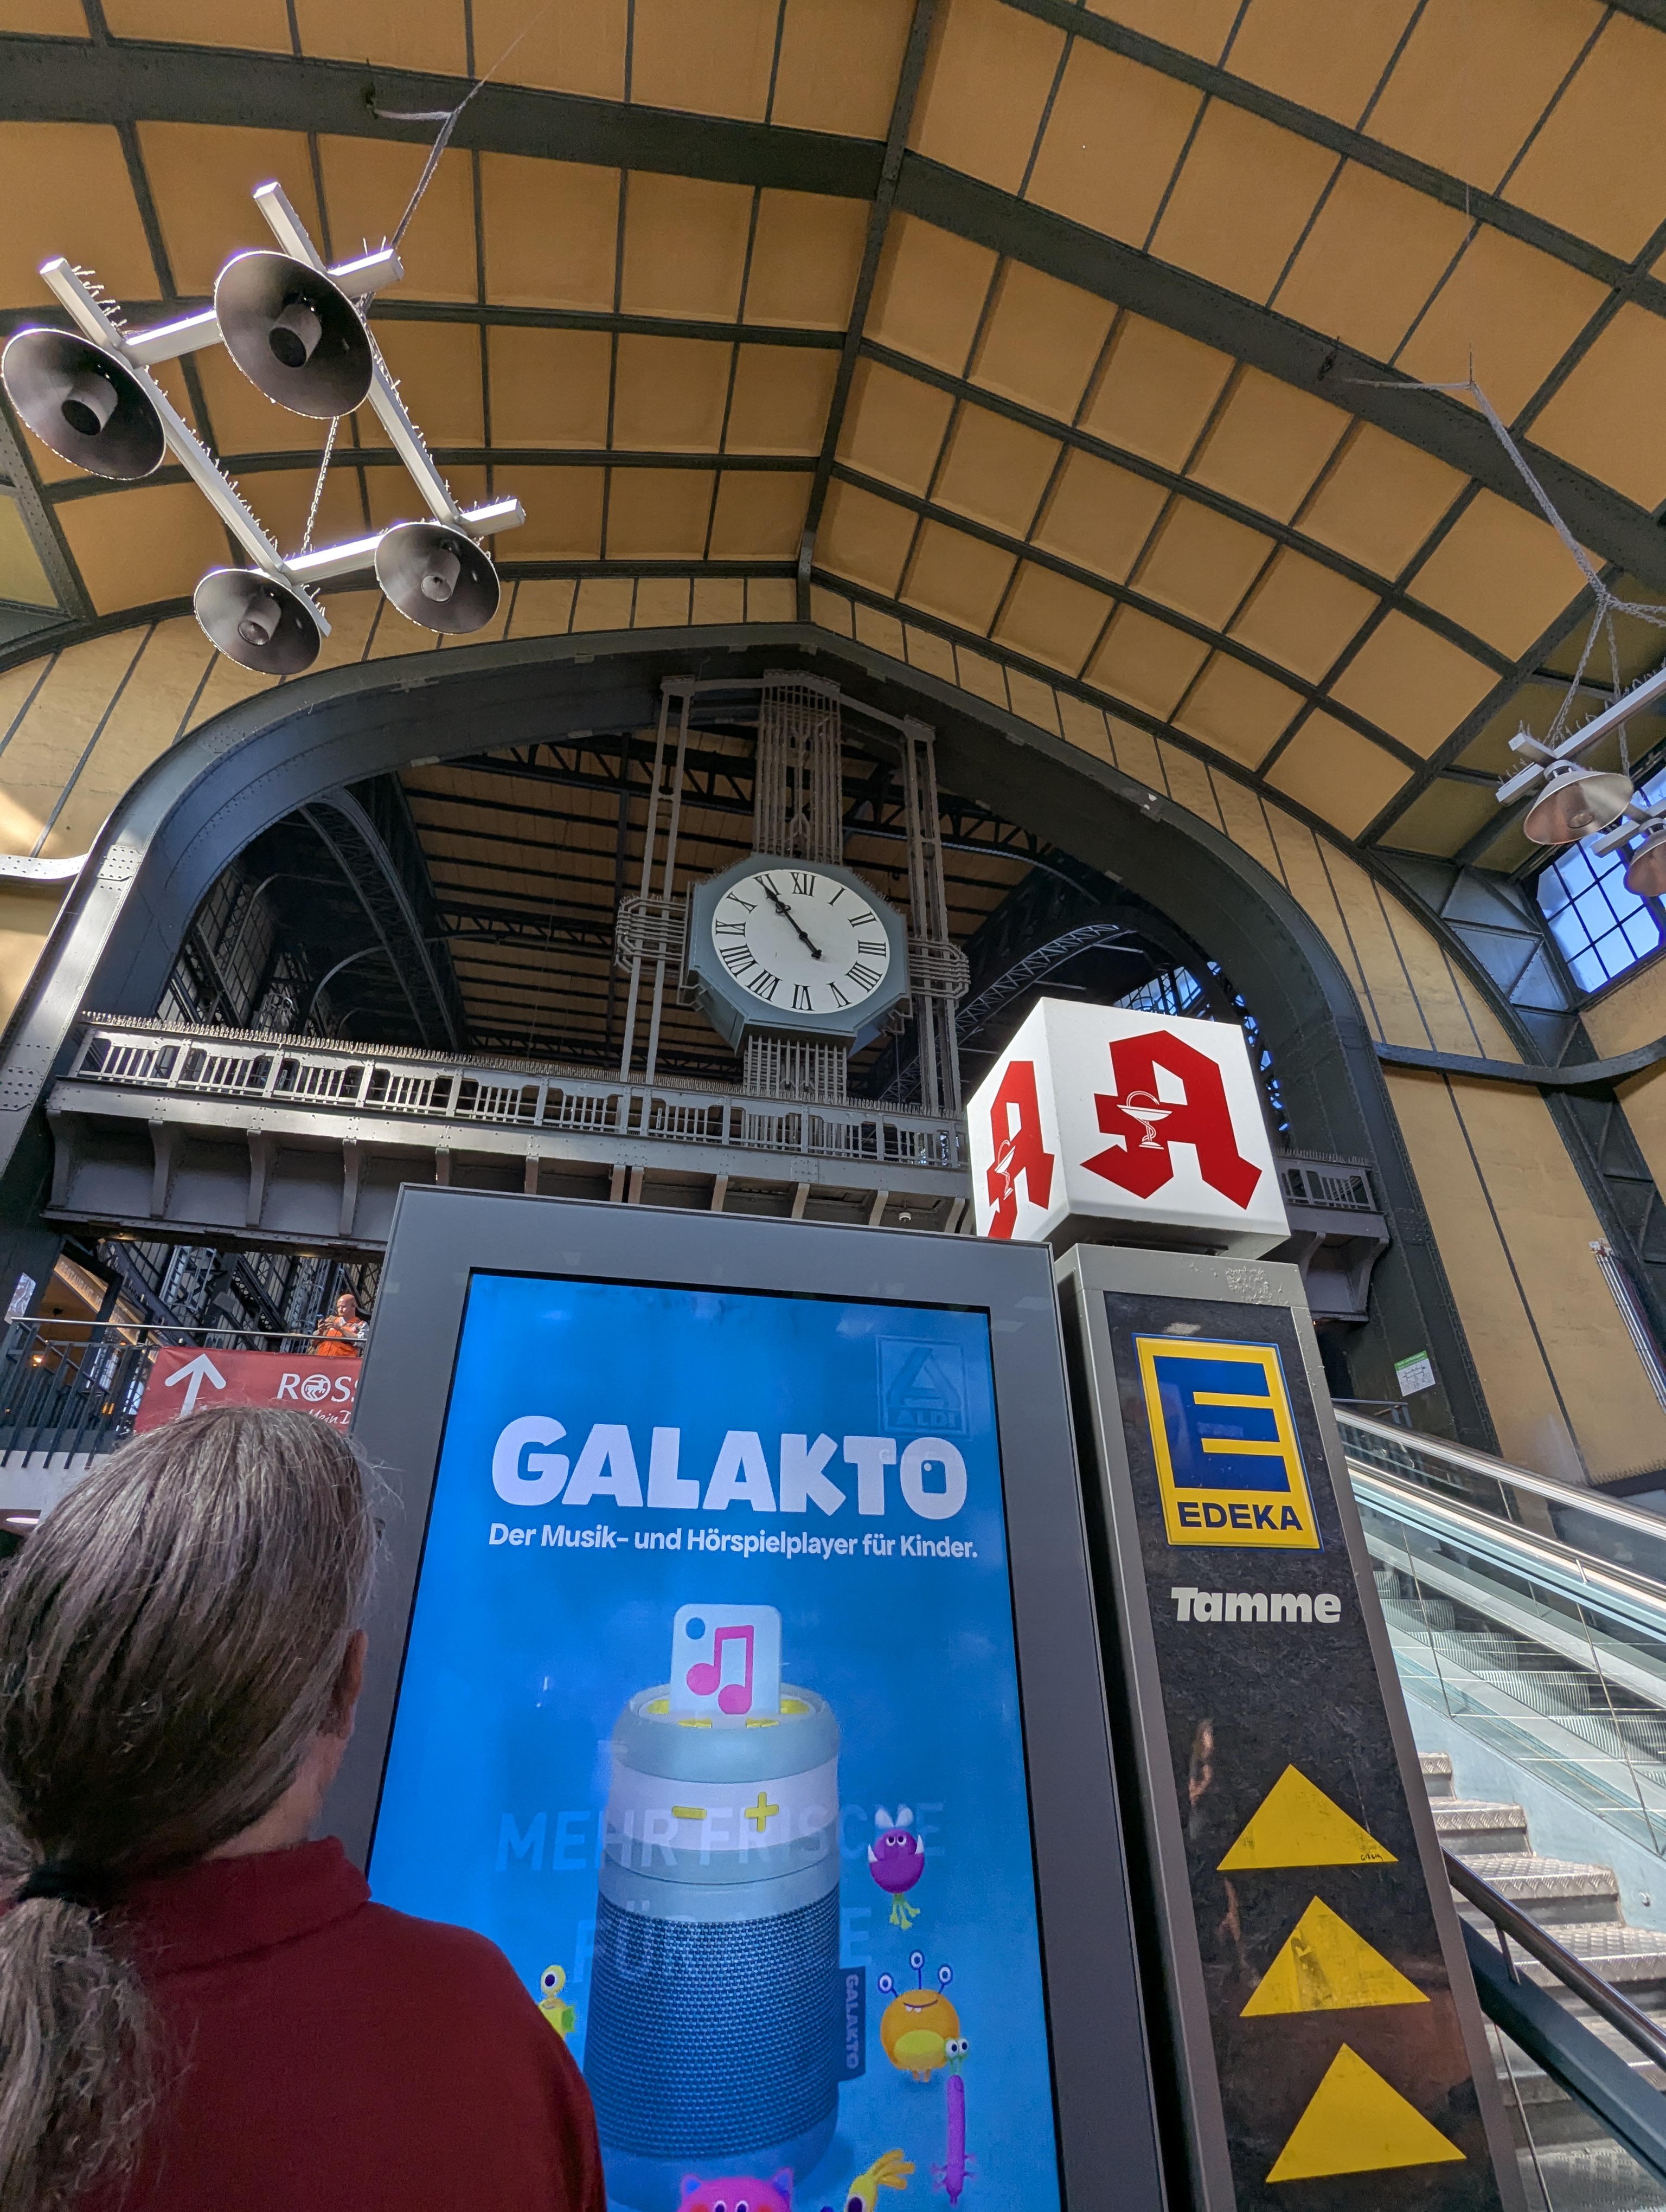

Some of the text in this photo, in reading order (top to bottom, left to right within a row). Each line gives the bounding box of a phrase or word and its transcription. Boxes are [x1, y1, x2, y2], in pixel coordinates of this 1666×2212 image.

[858, 940, 887, 958] III
[277, 1373, 358, 1403] ROS
[492, 1415, 968, 1520] GALAKTO
[1177, 1501, 1304, 1531] EDEKA
[489, 1522, 978, 1560] Der Musik- und Hörspielplayer für Kinder.
[1171, 1586, 1342, 1623] Tamme
[845, 1973, 860, 2070] GALAKTO
